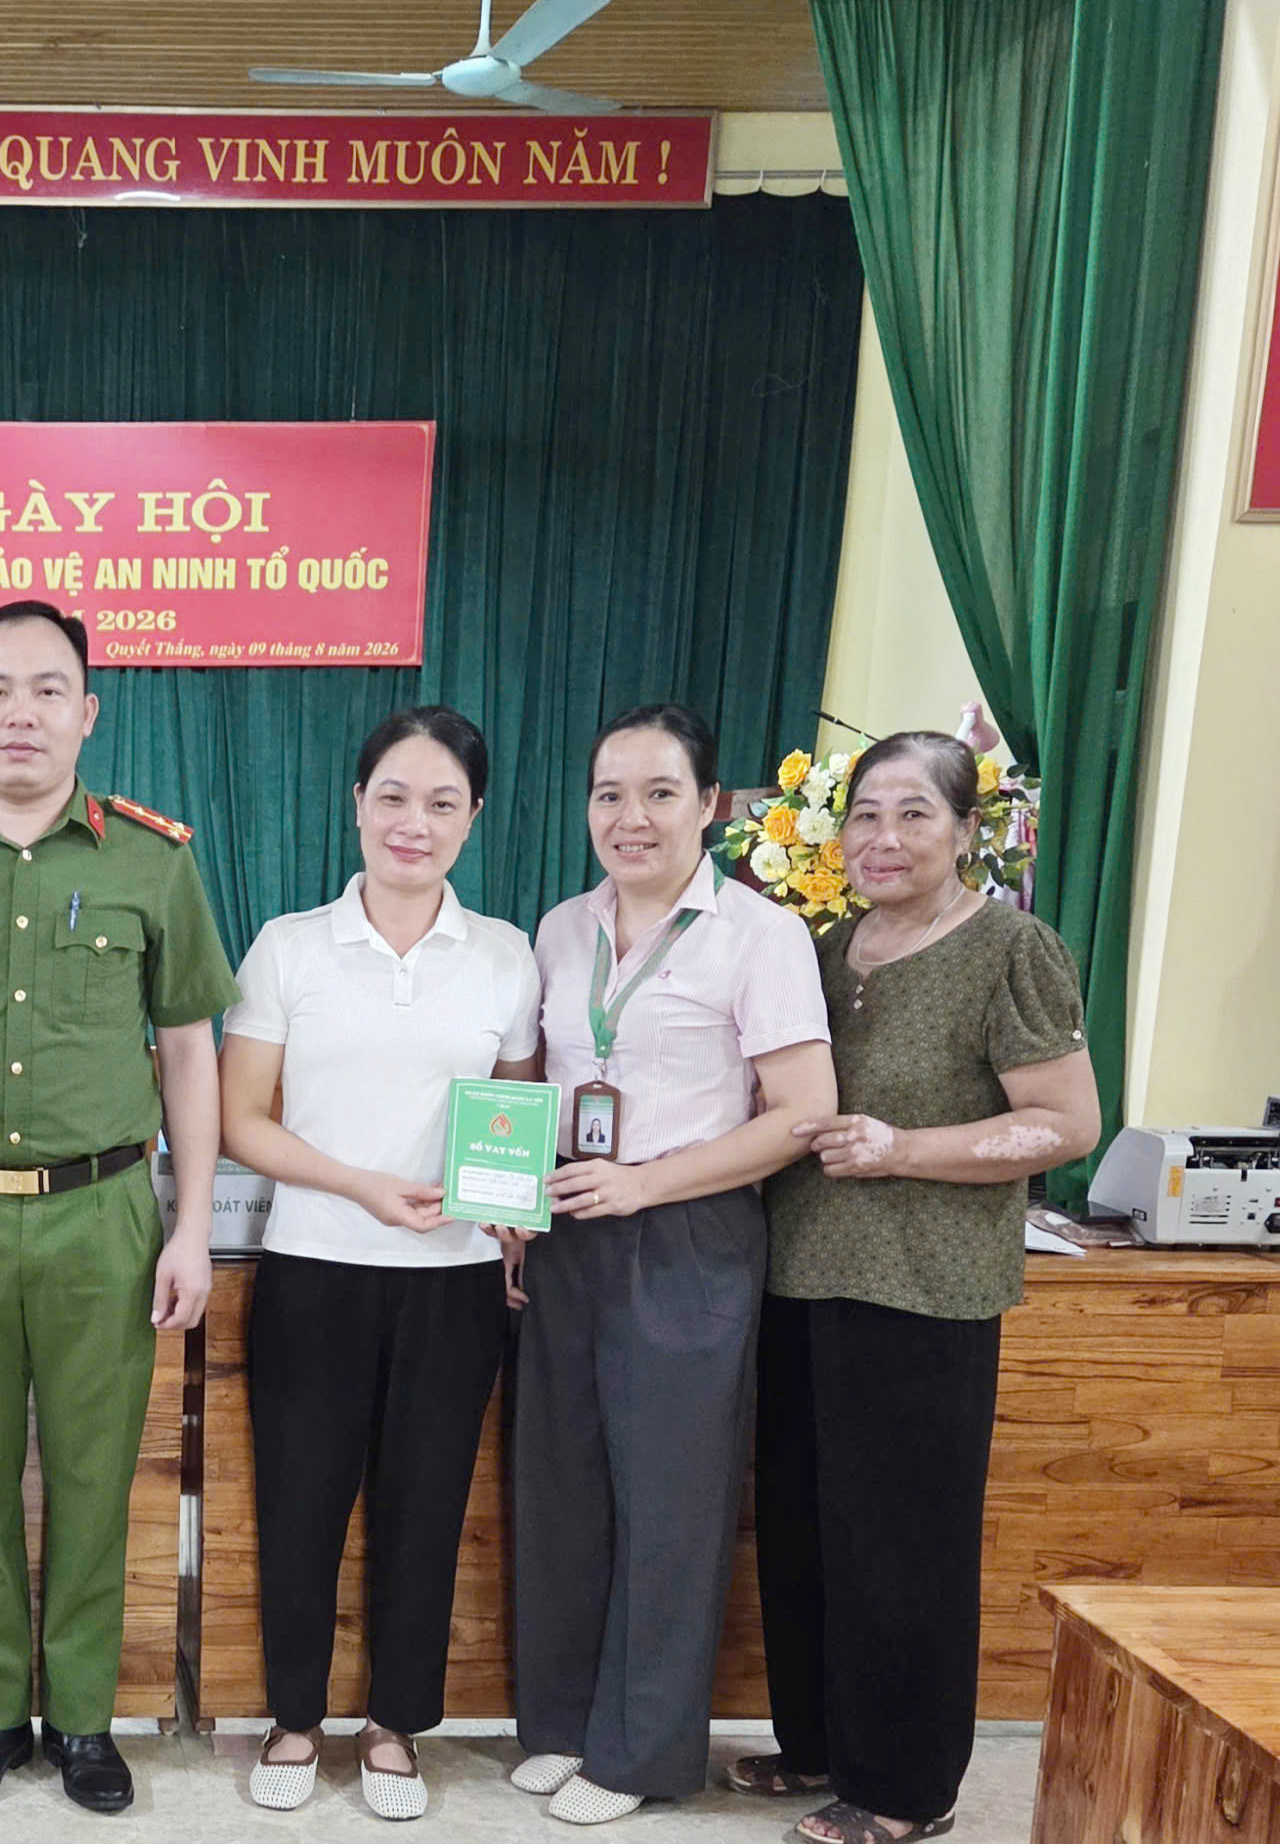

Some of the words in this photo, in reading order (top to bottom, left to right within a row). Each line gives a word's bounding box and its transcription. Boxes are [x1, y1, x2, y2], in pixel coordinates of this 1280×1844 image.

[198, 137, 329, 184] VINH
[347, 128, 505, 185] MUÔN
[524, 128, 640, 185] NĂM
[658, 142, 670, 184] !
[136, 478, 271, 544] HỘI
[42, 550, 84, 597] VỆ
[93, 556, 143, 591] AN
[152, 556, 237, 591] NINH
[246, 545, 290, 591] TỔ
[297, 546, 389, 593] QUỐC
[95, 609, 177, 631] 2026
[106, 638, 151, 659] Quyết
[155, 638, 205, 659] Thắng,
[209, 641, 245, 659] ngày
[248, 642, 267, 655] 09
[270, 642, 312, 659] tháng
[315, 642, 326, 656] 8
[328, 642, 361, 656] năm
[365, 642, 399, 655] 2026
[212, 1196, 241, 1213] OÁT
